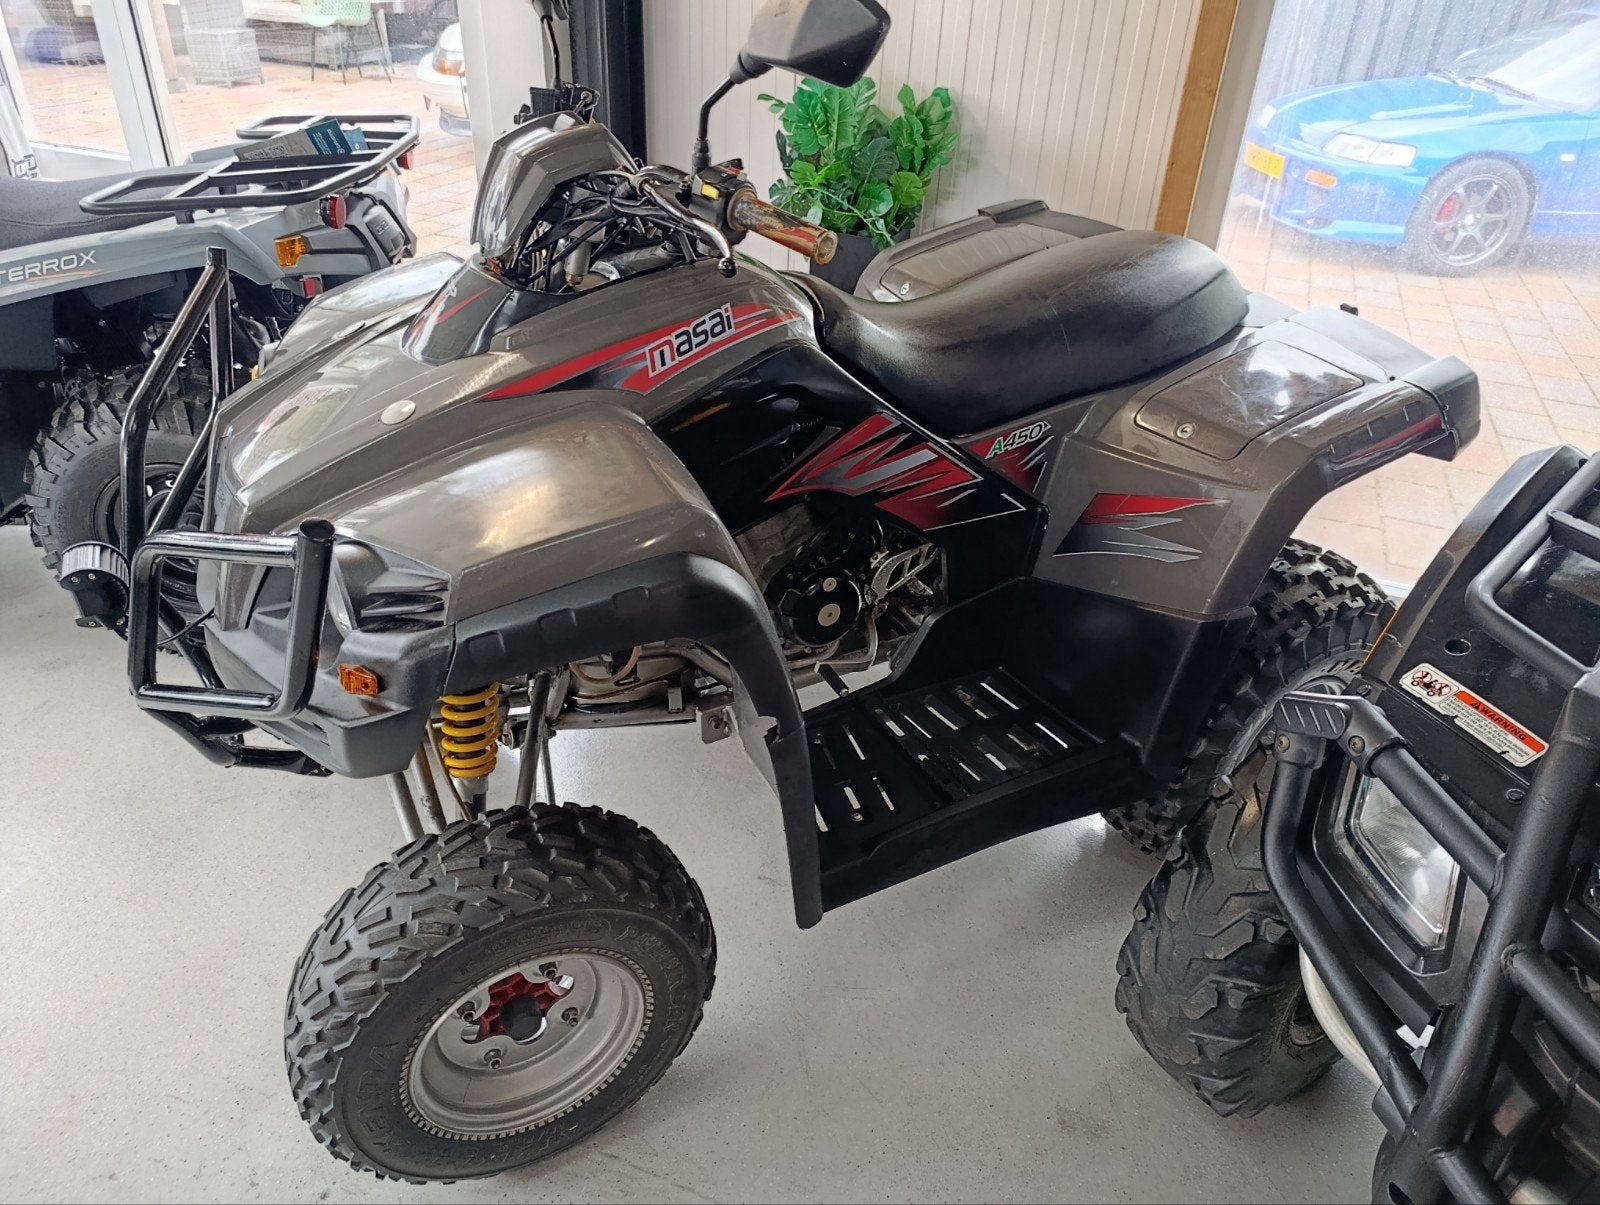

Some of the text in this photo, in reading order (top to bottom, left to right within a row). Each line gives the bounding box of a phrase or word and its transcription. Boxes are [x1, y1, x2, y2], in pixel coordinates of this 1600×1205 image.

[647, 304, 734, 375] masai
[985, 422, 1044, 459] A450
[1479, 706, 1528, 741] WARNING
